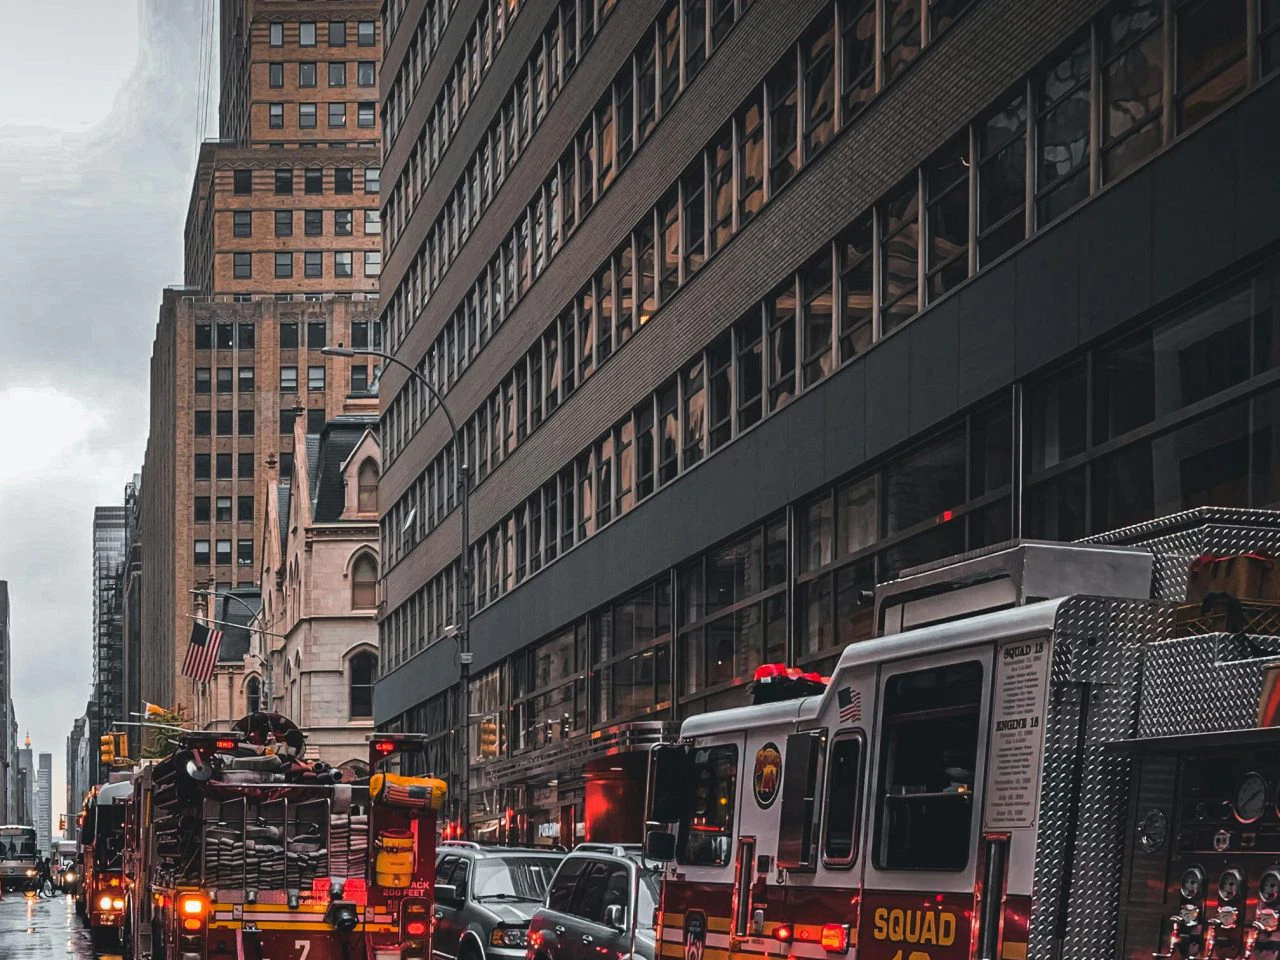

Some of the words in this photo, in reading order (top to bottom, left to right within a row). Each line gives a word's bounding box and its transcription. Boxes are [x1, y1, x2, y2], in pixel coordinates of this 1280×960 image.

[1003, 644, 1032, 660] SQUAD
[996, 718, 1027, 731] ENGINE
[1030, 716, 1039, 728] 18
[383, 888, 401, 898] 200
[404, 888, 425, 898] FEET
[410, 881, 430, 890] ACK
[873, 907, 957, 947] SQUAD
